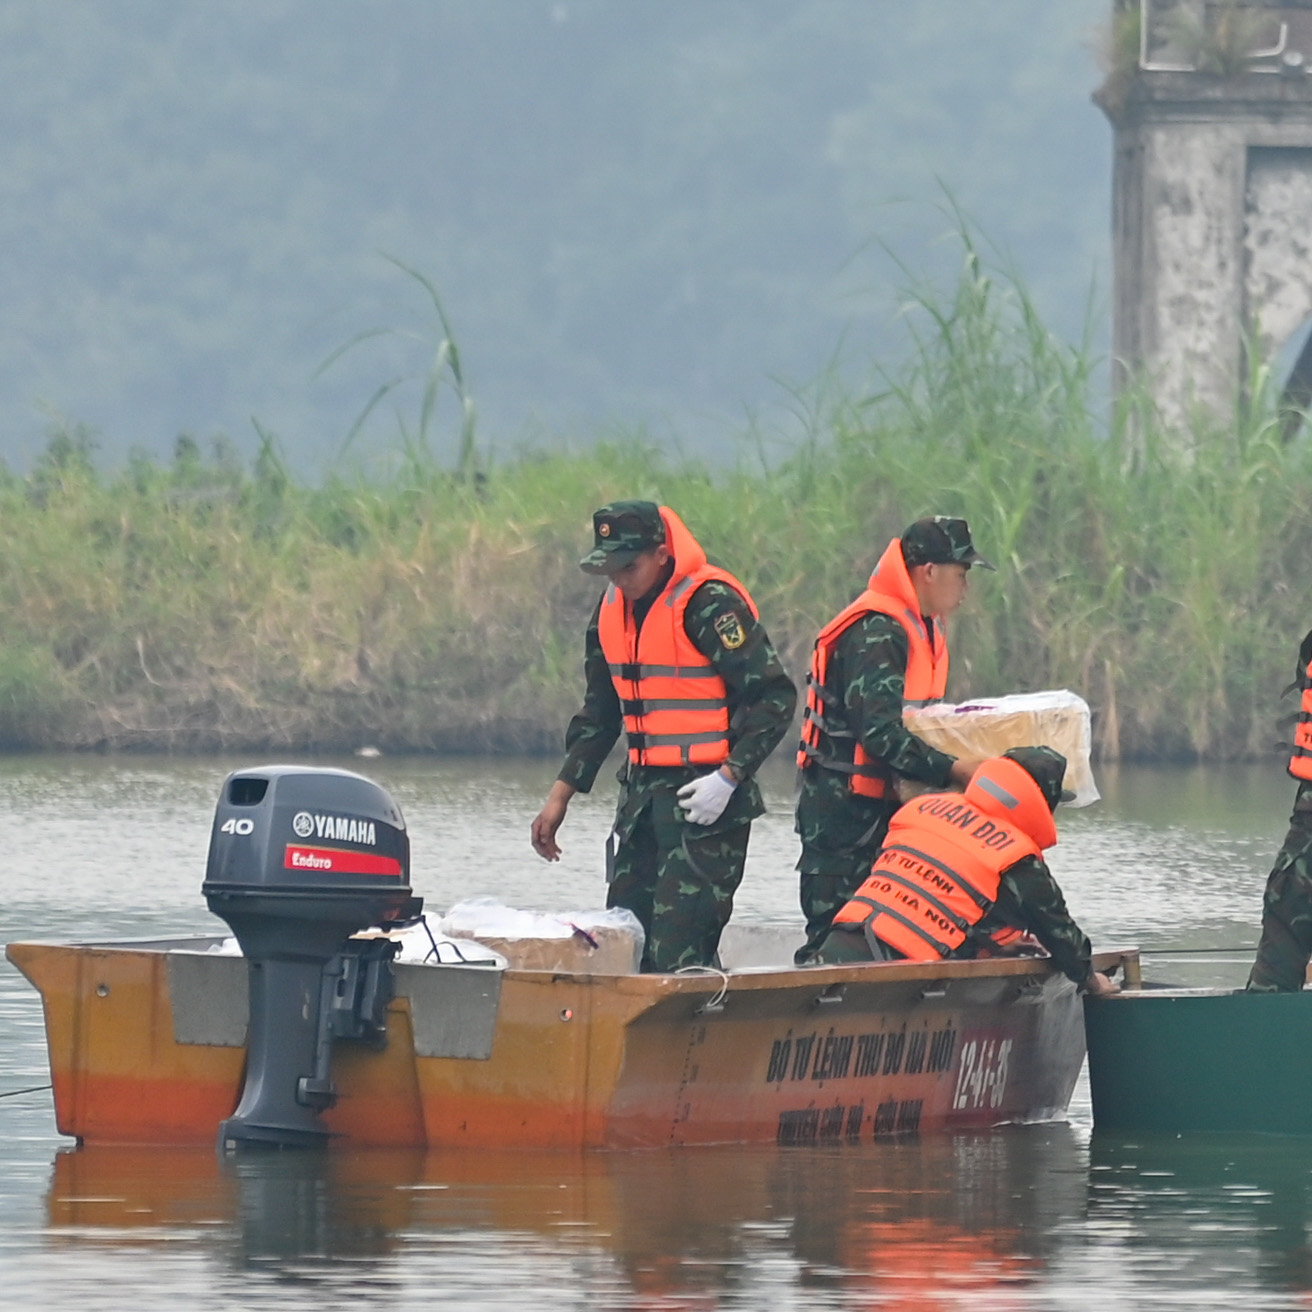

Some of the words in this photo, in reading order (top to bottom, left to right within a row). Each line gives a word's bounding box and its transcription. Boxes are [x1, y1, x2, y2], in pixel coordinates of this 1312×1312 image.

[221, 818, 254, 835] 40
[315, 815, 376, 845] YAMAHA
[919, 798, 980, 830] QUÂN
[970, 821, 1015, 851] ĐỘI
[291, 852, 332, 869] Enduro
[766, 1029, 792, 1091] BỘ
[791, 1032, 816, 1080] TƯ
[812, 1027, 854, 1088] LỆNH
